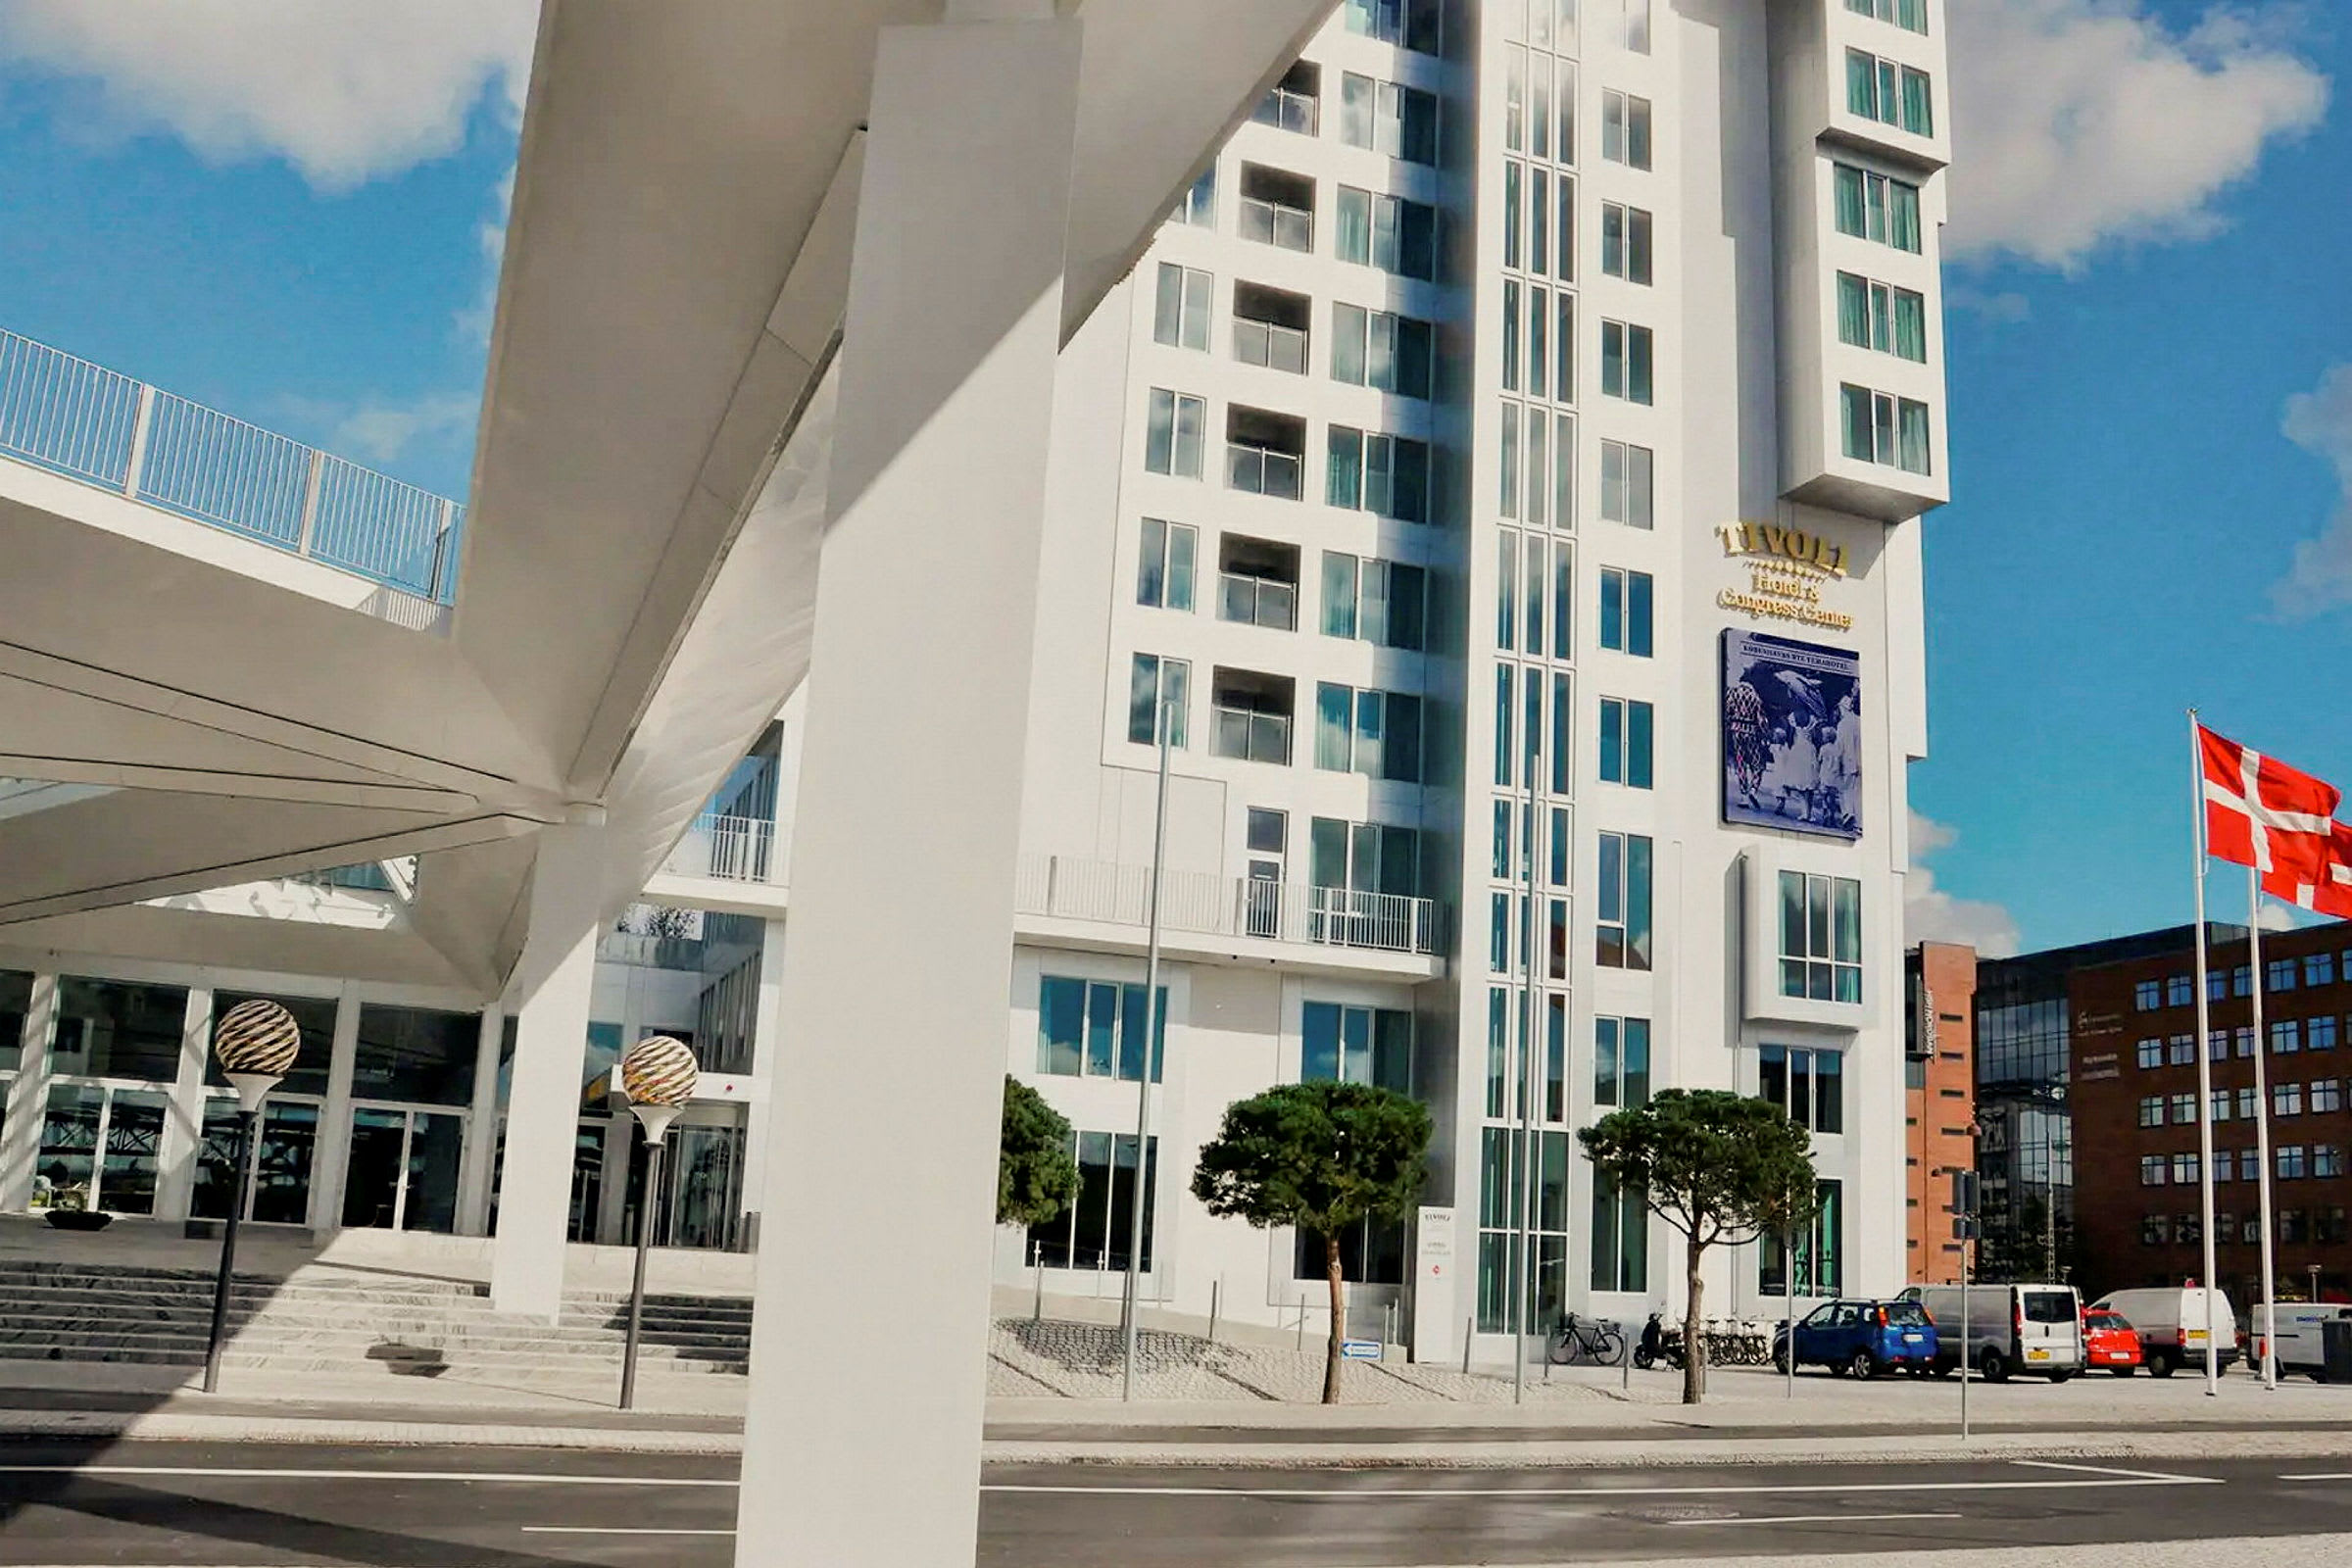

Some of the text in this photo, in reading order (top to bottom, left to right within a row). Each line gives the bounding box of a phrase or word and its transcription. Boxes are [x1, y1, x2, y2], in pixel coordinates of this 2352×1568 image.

[1719, 522, 1848, 577] TIVOLI
[1754, 574, 1806, 599] Hotel
[1720, 587, 1800, 616] Congress
